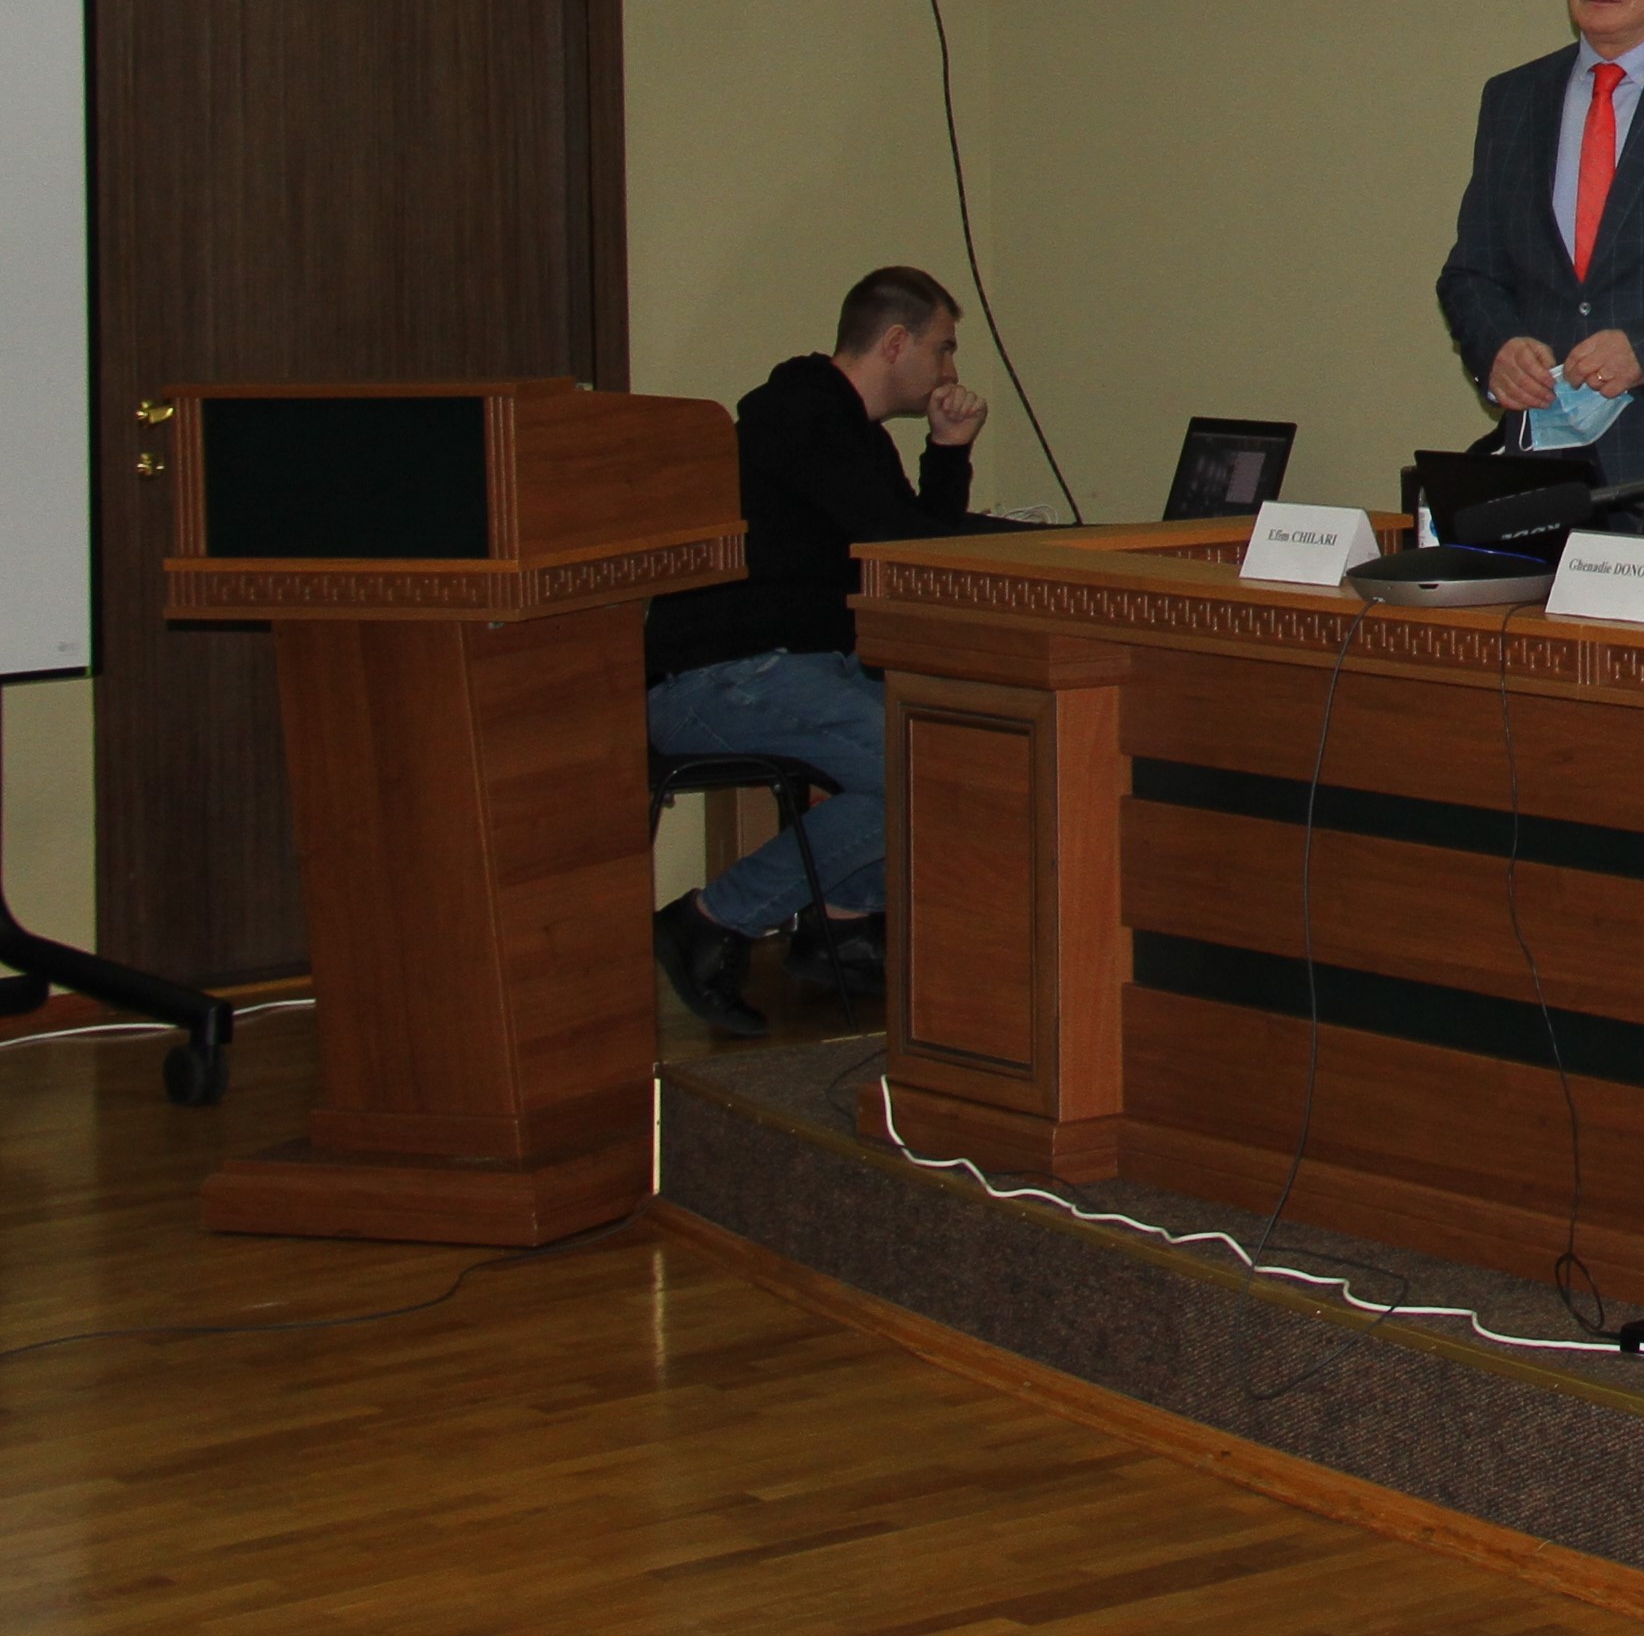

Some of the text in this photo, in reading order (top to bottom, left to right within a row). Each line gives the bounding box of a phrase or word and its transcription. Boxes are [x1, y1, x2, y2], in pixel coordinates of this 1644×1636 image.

[1268, 528, 1338, 546] Efim CHILARI
[1569, 558, 1613, 574] Ghenadie
